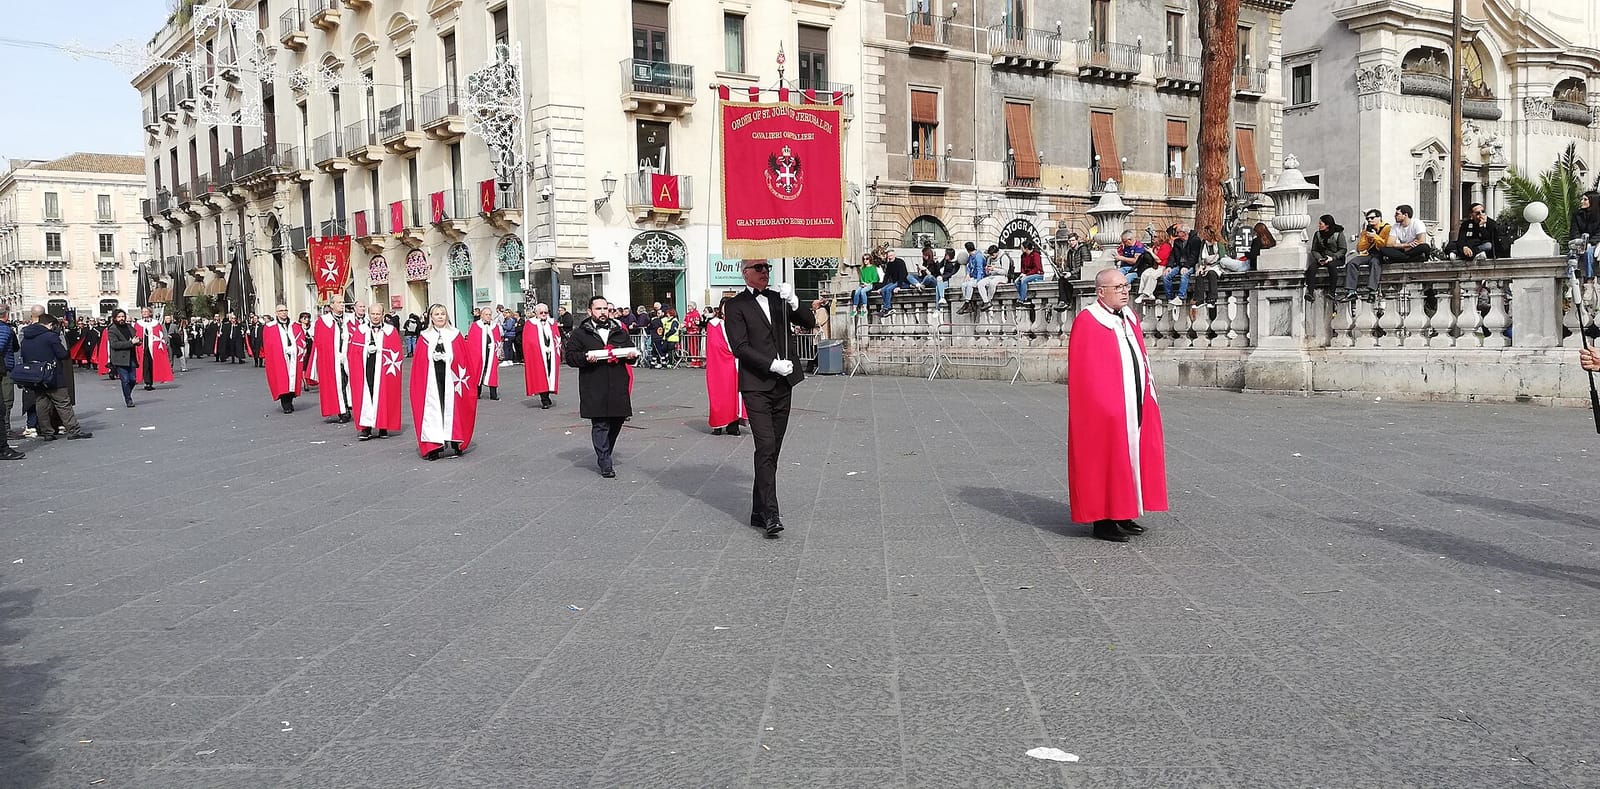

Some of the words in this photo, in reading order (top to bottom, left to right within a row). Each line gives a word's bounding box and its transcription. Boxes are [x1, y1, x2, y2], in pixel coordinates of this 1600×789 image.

[752, 110, 761, 121] OF
[762, 109, 771, 119] ST.
[795, 112, 833, 134] JERUSALEM
[483, 190, 490, 206] A
[659, 184, 672, 202] A
[755, 218, 790, 226] PRIORATO
[714, 261, 733, 272] Don
